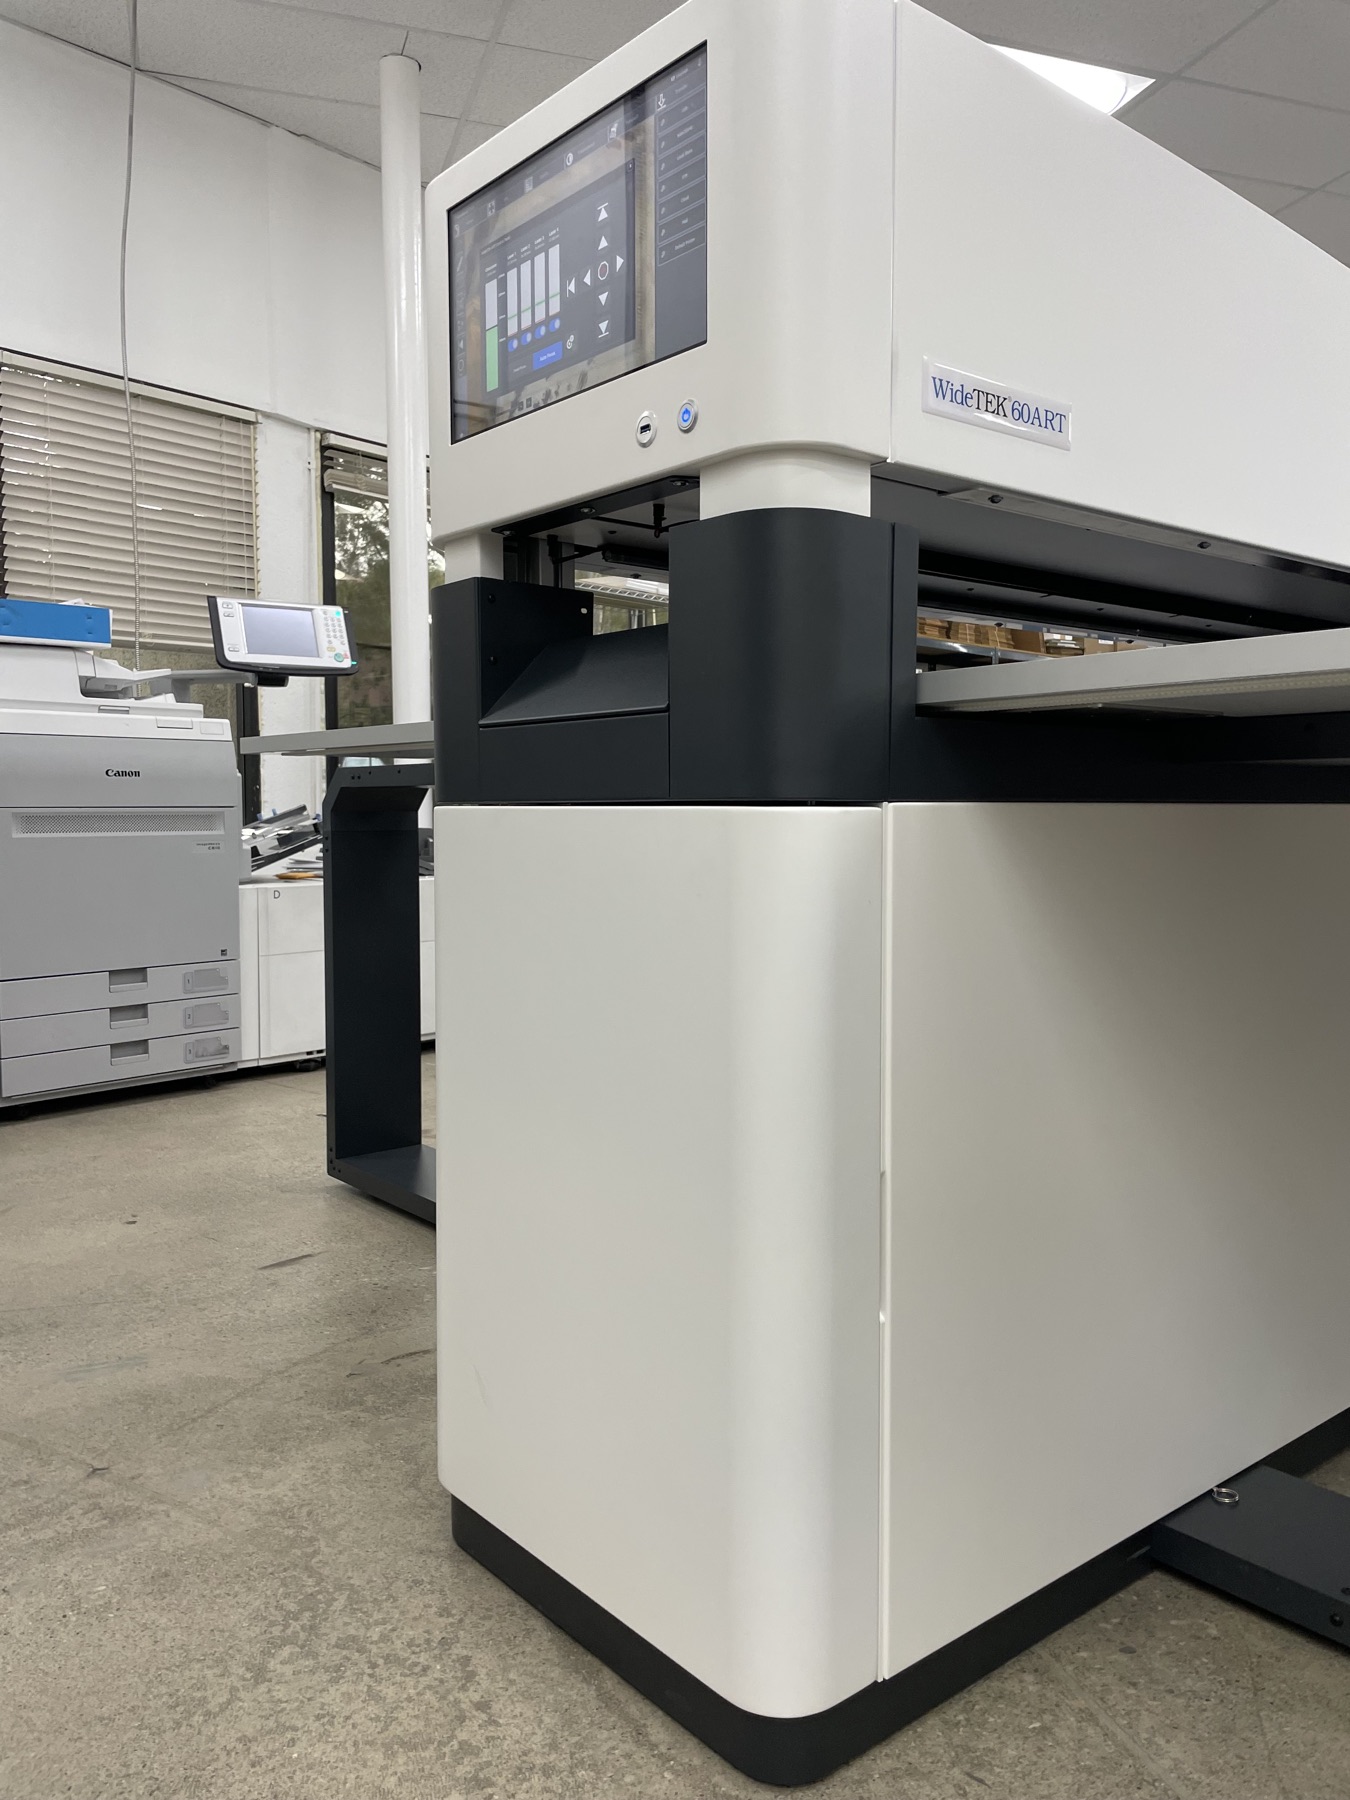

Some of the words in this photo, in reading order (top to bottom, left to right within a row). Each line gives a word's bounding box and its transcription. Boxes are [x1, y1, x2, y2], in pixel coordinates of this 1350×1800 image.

[1011, 400, 1067, 434] 60ART
[105, 768, 141, 778] Canon
[273, 889, 281, 899] D
